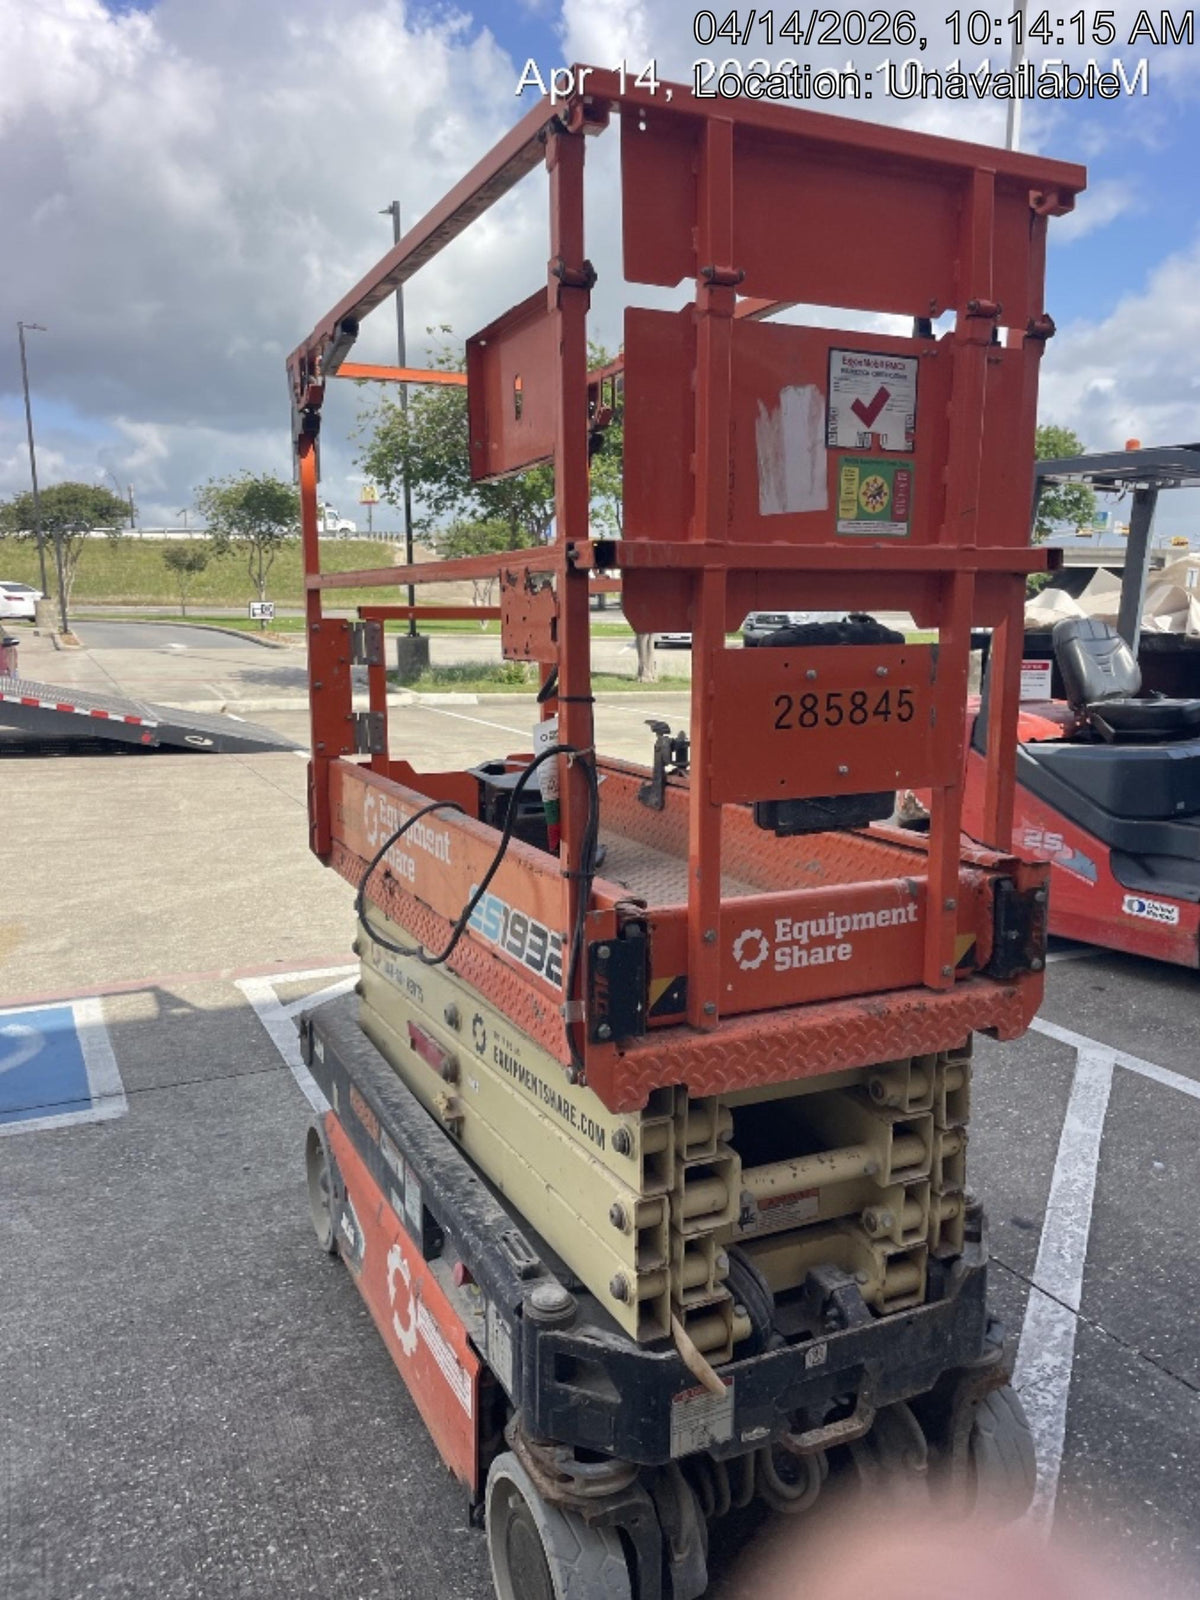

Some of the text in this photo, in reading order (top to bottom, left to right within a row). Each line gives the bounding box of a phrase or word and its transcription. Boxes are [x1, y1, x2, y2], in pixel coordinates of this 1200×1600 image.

[774, 689, 914, 730] 285845
[467, 884, 562, 992] ES1932
[774, 902, 918, 944] Equipment
[774, 943, 853, 971] Share
[493, 1044, 606, 1151] EQUIPMENTSHARE.COM
